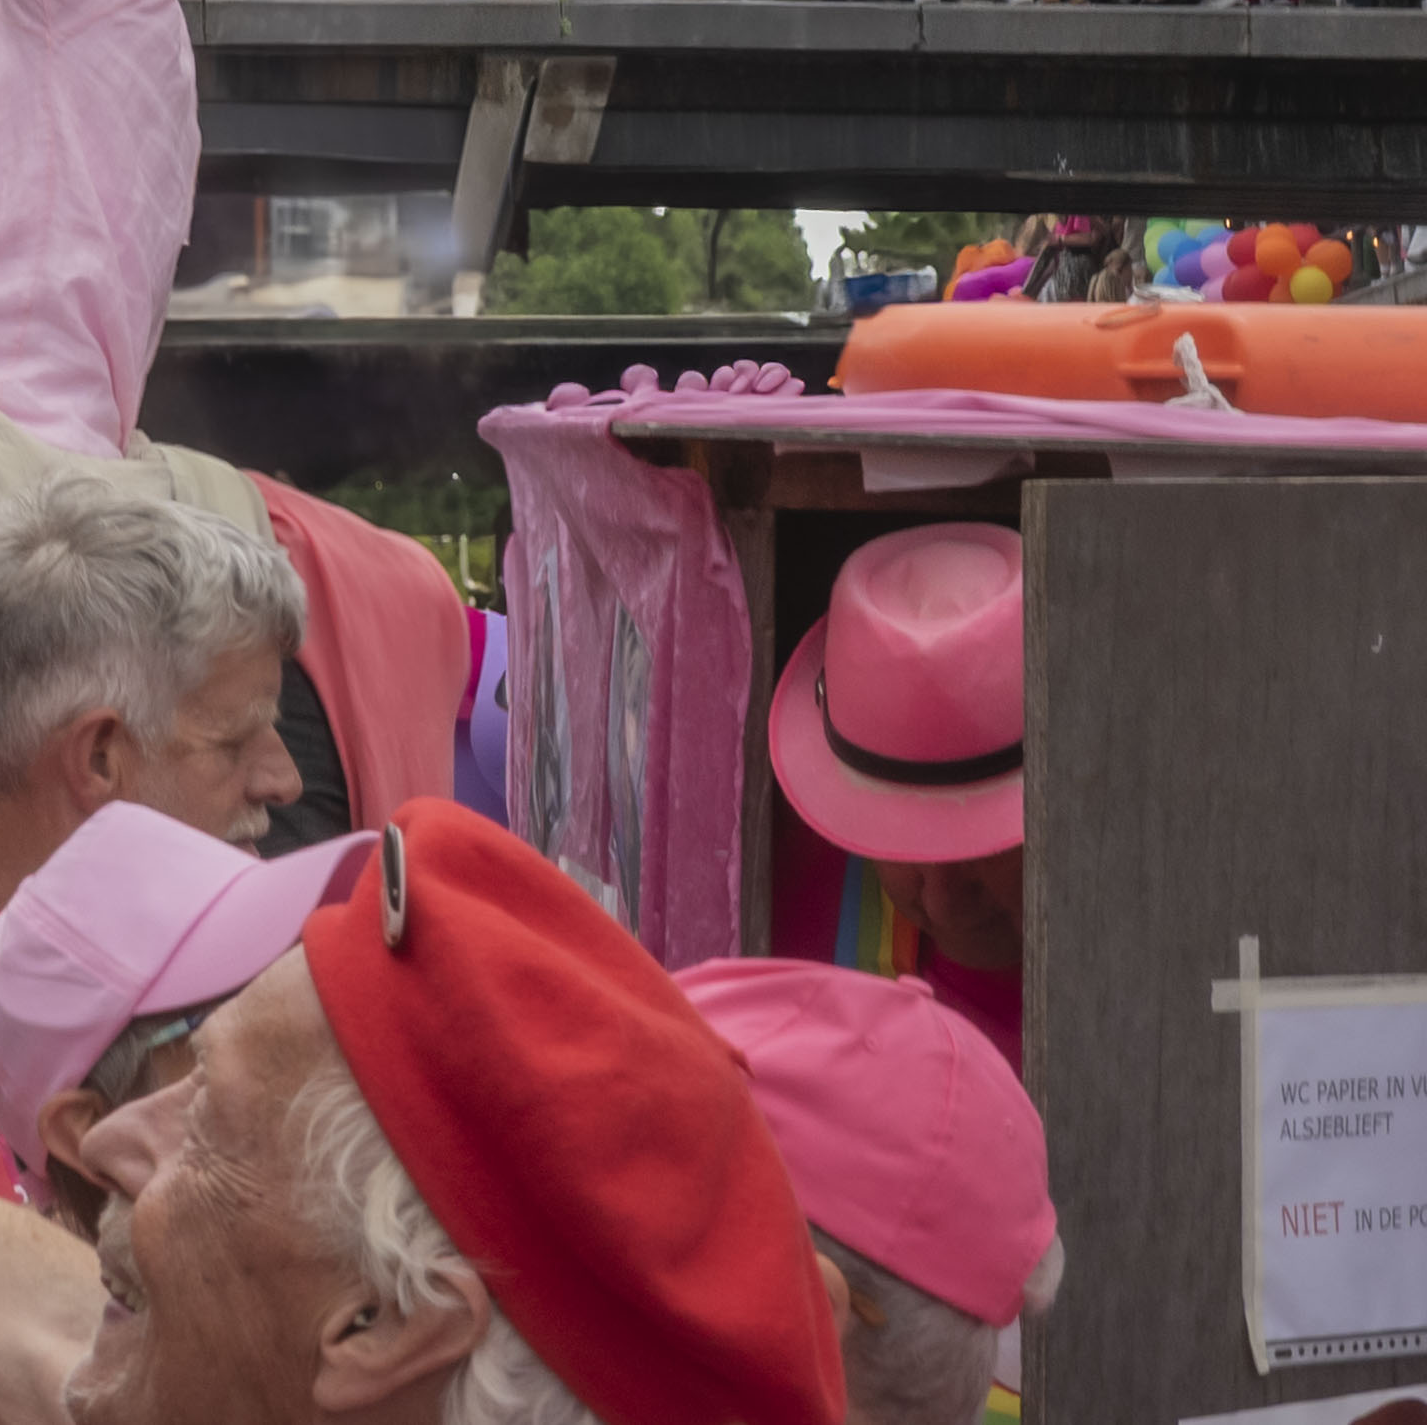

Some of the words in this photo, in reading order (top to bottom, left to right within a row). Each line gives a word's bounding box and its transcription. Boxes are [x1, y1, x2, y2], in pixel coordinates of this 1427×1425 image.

[1281, 1080, 1310, 1106] WC
[1317, 1076, 1379, 1103] PAPIER
[1387, 1075, 1405, 1099] IN
[1280, 1110, 1394, 1142] ALSJEBLIEFT
[1281, 1199, 1345, 1239] NIET
[1355, 1207, 1373, 1233] IN
[1379, 1205, 1403, 1231] DE
